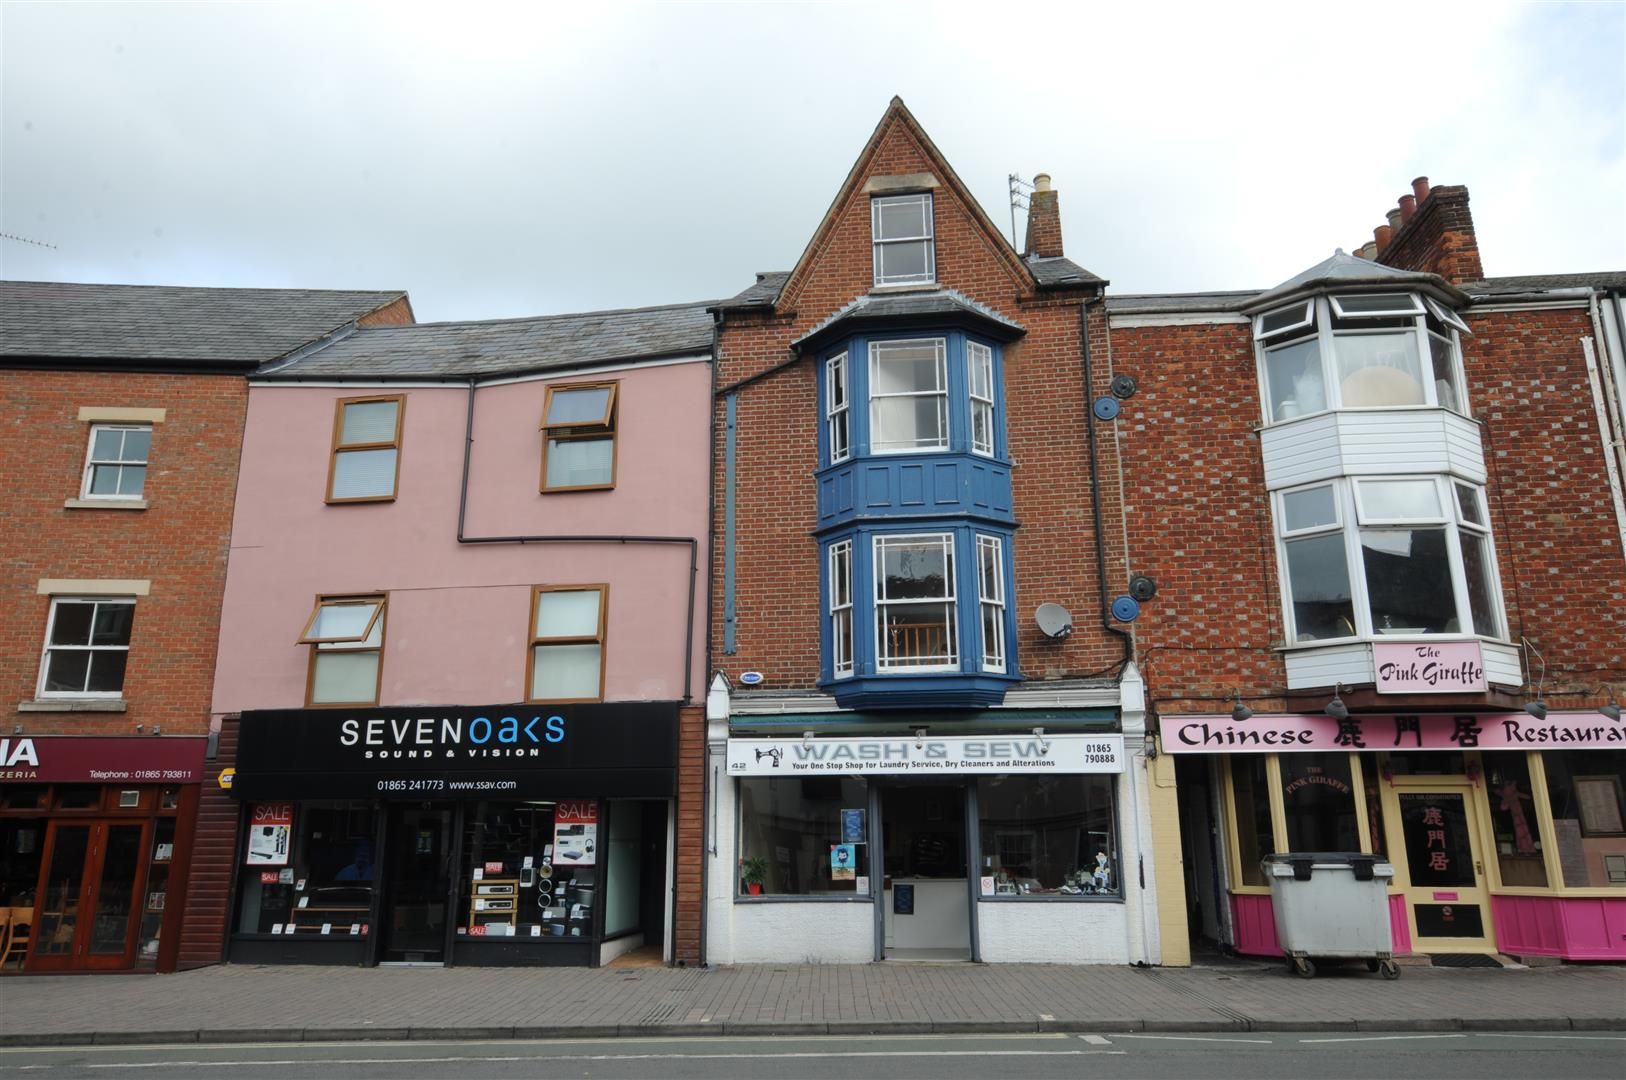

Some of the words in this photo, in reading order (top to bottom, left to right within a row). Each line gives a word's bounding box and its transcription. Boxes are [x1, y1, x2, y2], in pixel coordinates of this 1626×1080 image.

[1415, 646, 1441, 658] The
[1379, 662, 1419, 681] Pink
[1422, 661, 1483, 686] Giraffe
[1178, 723, 1315, 746] Chinese
[1501, 719, 1626, 743] Restaura
[365, 750, 433, 759] SOUND
[446, 750, 455, 758] &
[468, 748, 540, 758] VISION
[792, 743, 909, 761] WASH
[925, 743, 948, 759] &
[963, 742, 1053, 759] SEW
[1086, 744, 1112, 754] 01865
[792, 763, 809, 771] Your
[810, 762, 824, 770] One
[826, 762, 843, 771] Stop
[845, 761, 863, 771] Shop
[866, 761, 877, 769] for
[879, 761, 910, 770] Laundry
[911, 760, 943, 769] Service,
[945, 760, 958, 769] Dry
[960, 760, 994, 768] Cleaners
[996, 759, 1010, 767] and
[1012, 759, 1056, 767] Alterations
[1085, 754, 1116, 764] 790888
[89, 770, 129, 779] Telephone
[135, 770, 161, 778] 01865
[162, 770, 192, 778] 793811
[377, 780, 407, 790] 01865
[409, 780, 444, 790] 241773
[449, 780, 517, 790] www.ssav.com
[255, 805, 289, 820] SALE
[558, 803, 596, 819] SALE
[469, 926, 486, 935] SALE
